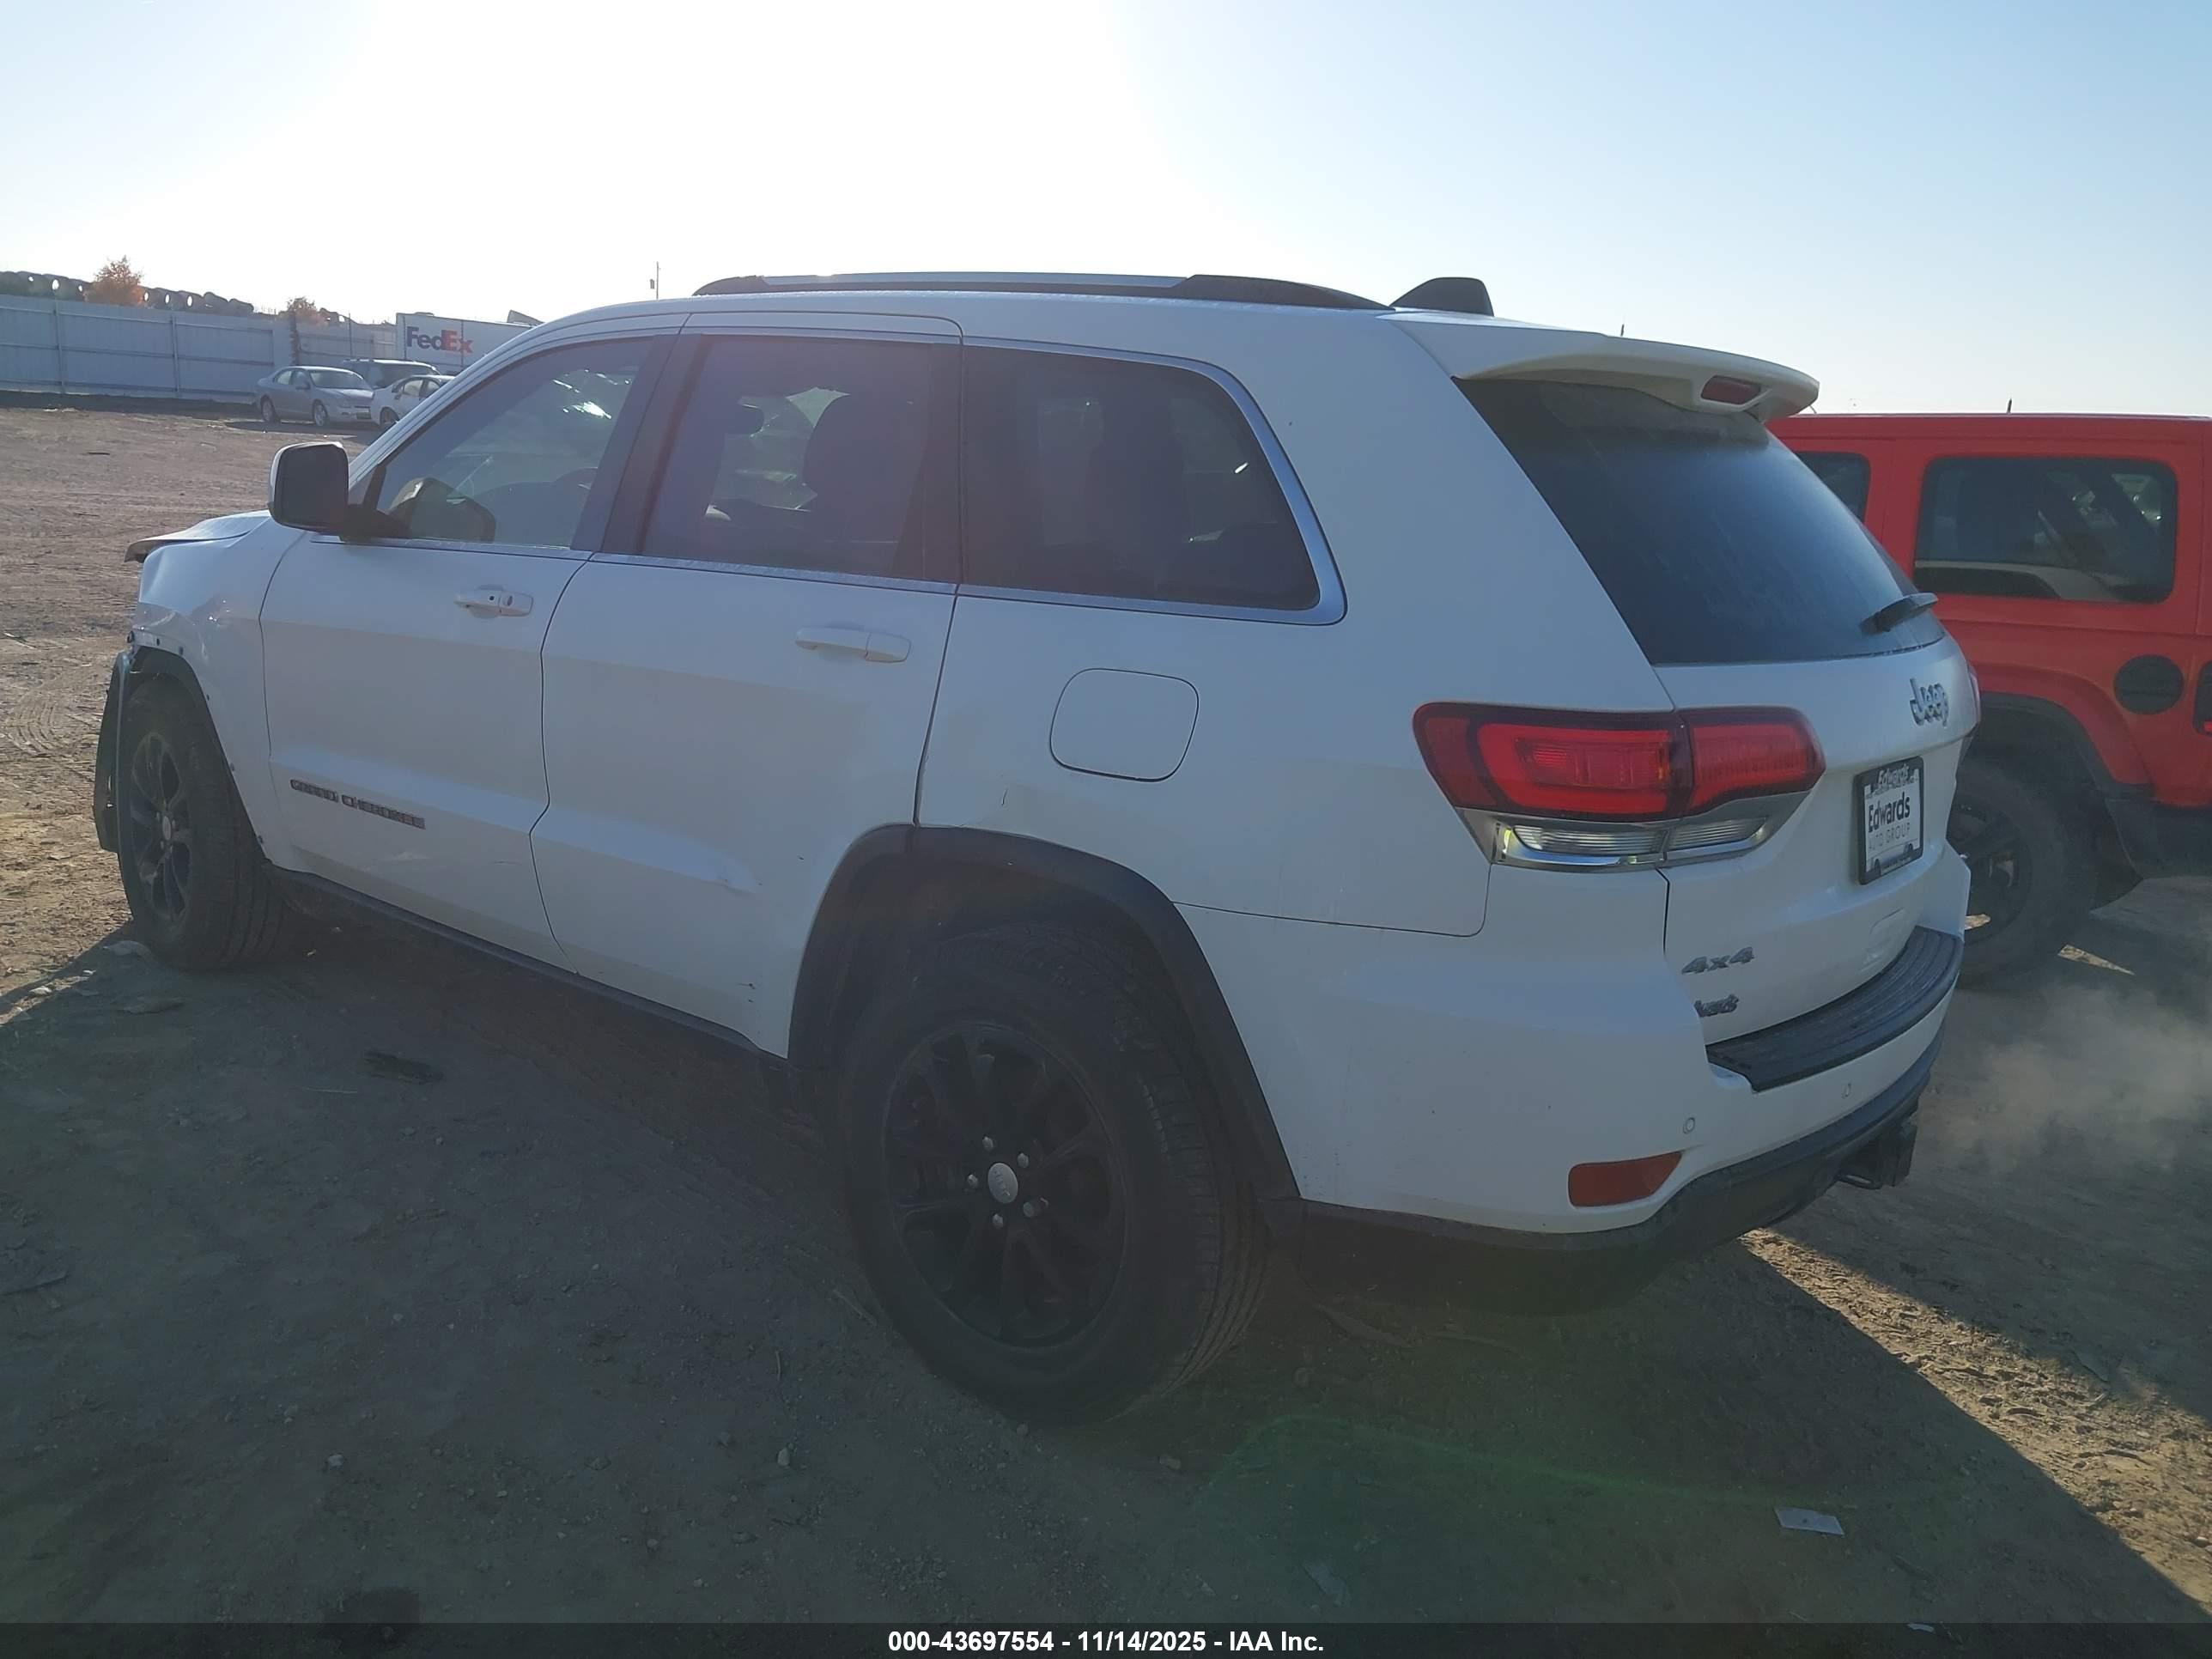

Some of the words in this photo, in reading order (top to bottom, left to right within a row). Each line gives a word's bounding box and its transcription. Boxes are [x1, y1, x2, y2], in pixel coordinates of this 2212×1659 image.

[407, 325, 473, 354] FedEx
[1909, 678, 1949, 727] Jeep
[1868, 791, 1911, 833] Edwards
